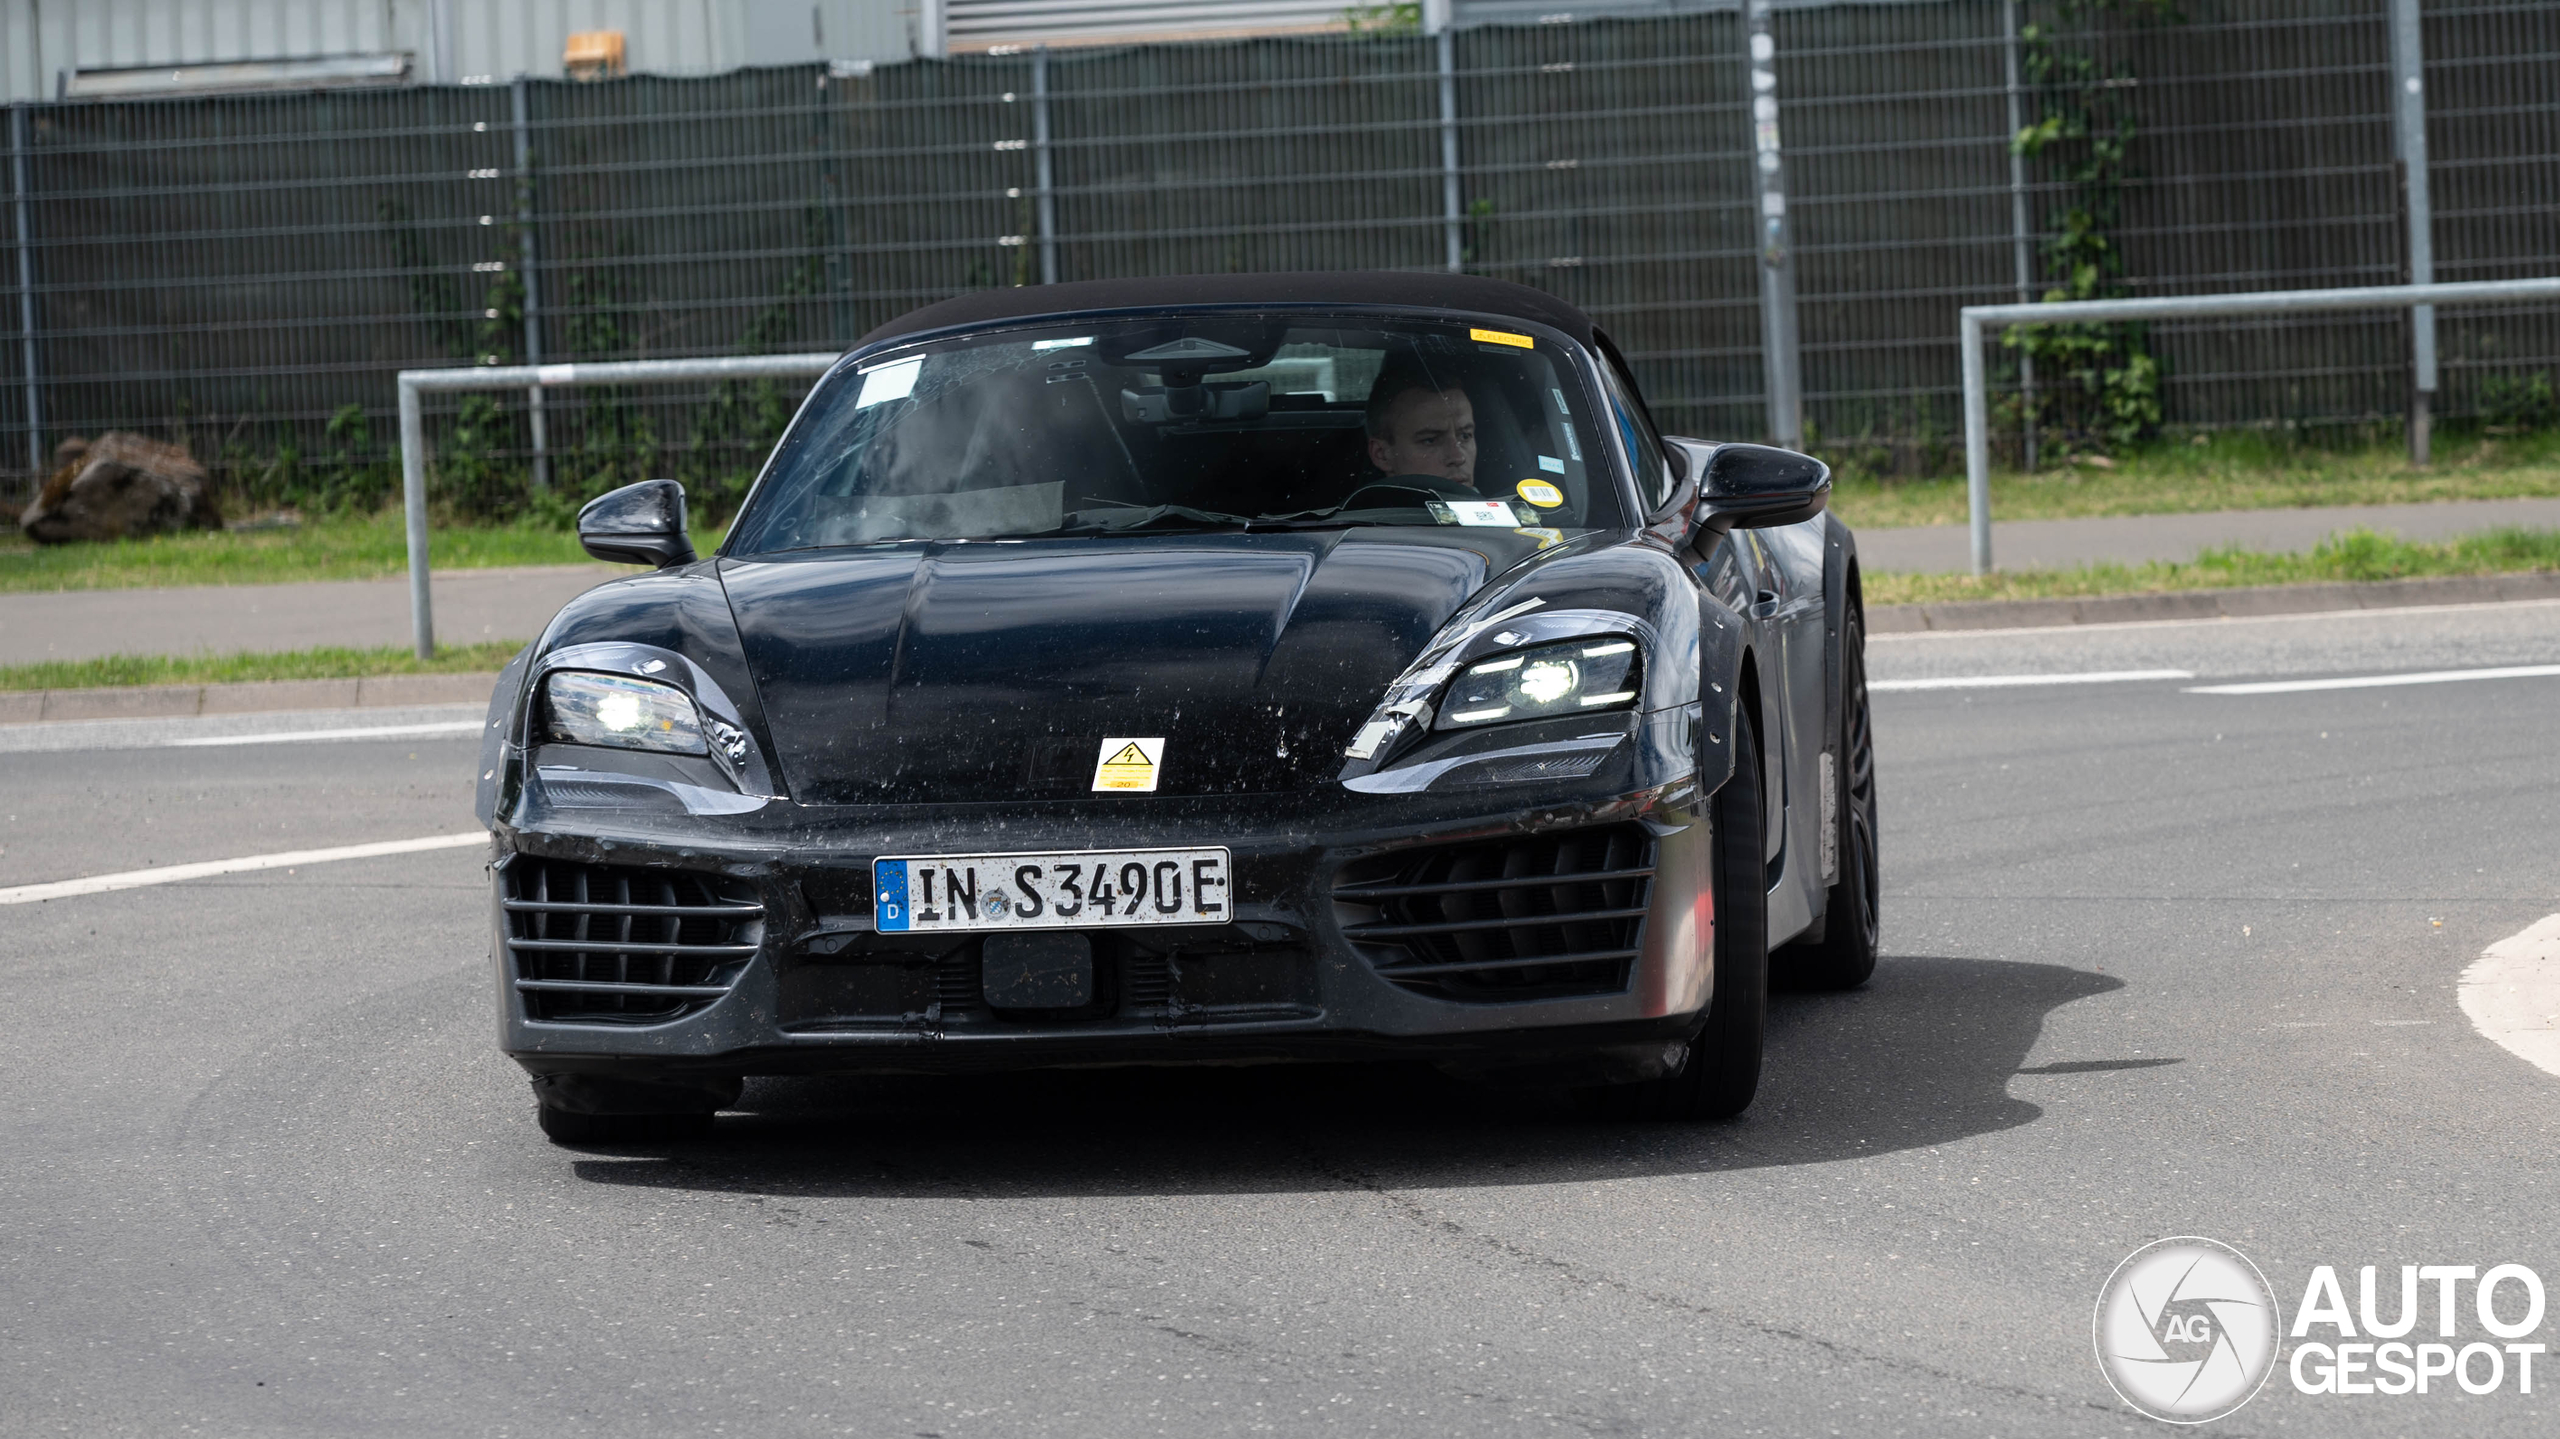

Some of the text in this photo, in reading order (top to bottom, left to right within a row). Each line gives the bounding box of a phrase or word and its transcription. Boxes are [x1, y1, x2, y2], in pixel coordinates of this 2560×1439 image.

[1487, 333, 1531, 347] ELECTRIC
[917, 867, 978, 921] IN
[887, 904, 899, 919] D
